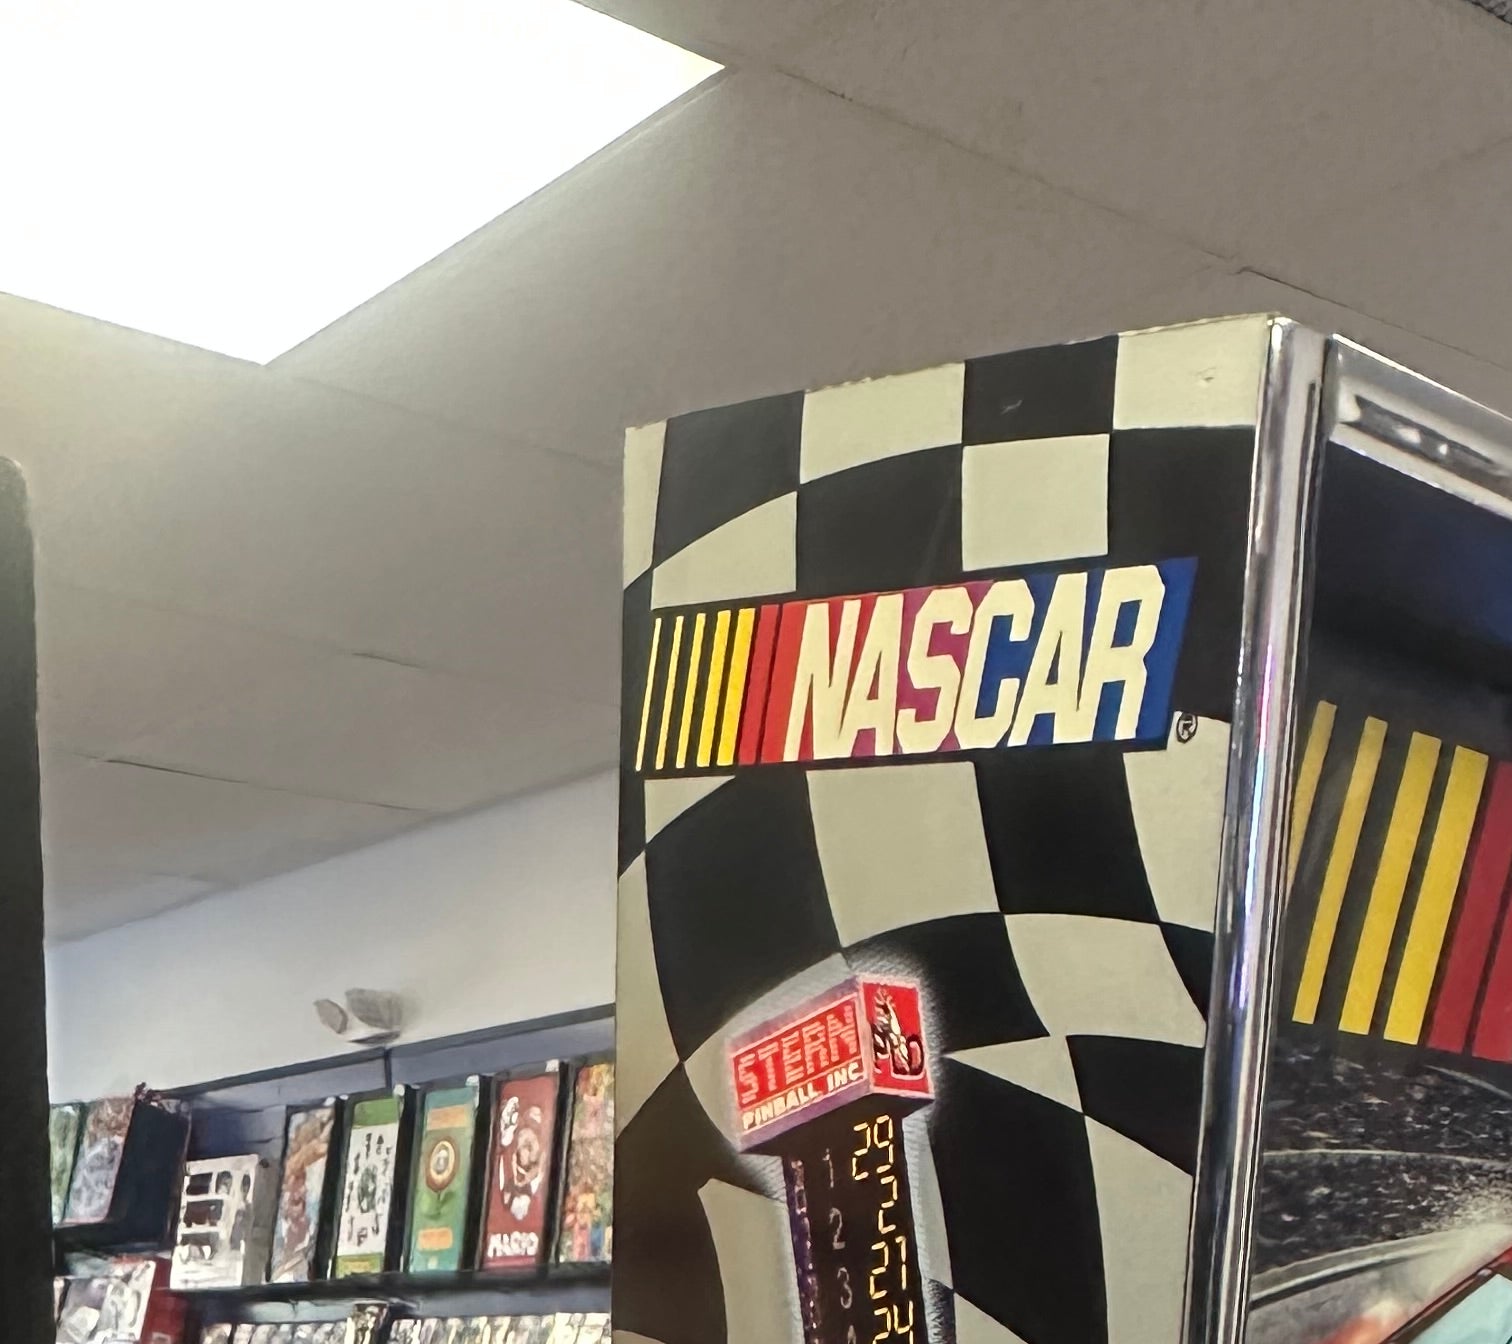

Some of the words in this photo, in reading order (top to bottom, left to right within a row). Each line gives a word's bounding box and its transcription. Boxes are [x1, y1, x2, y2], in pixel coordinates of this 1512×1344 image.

[783, 564, 1165, 760] NASCAR
[738, 1005, 858, 1105] STERN
[742, 1082, 821, 1130] PINBALL
[823, 1148, 835, 1188] 1
[852, 1114, 894, 1180] 29
[487, 1231, 540, 1258] MARIO
[829, 1207, 846, 1250] 2
[877, 1175, 898, 1233] 2
[836, 1265, 853, 1309] 3
[869, 1235, 907, 1299] 21
